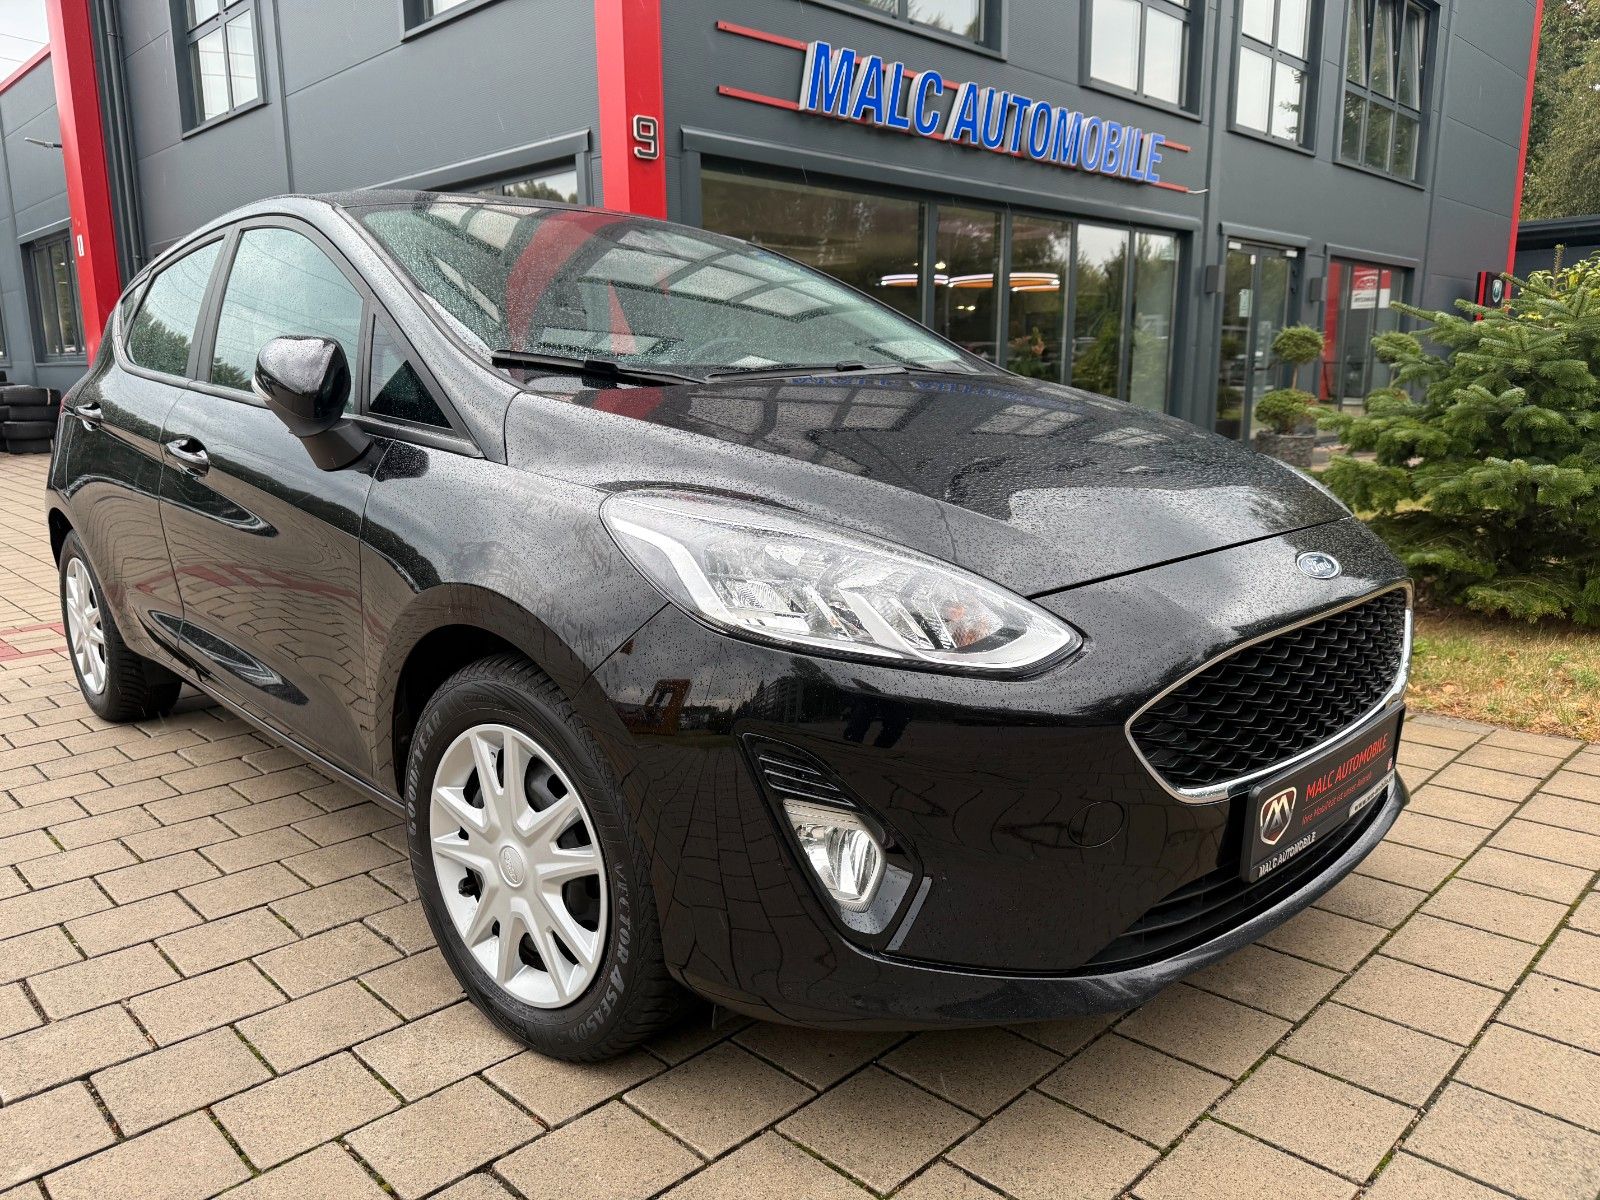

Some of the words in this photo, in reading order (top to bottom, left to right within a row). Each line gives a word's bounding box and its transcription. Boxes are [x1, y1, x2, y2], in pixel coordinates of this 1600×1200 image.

[633, 114, 659, 159] 9
[800, 40, 944, 136] MALC
[943, 81, 1166, 184] AUTOMOBILE
[1305, 557, 1332, 573] Ford
[406, 710, 442, 836] GOODYEAR
[1305, 769, 1335, 801] MALC
[1334, 733, 1388, 784] AUTOMOBILE
[1258, 857, 1279, 878] MALC
[1278, 831, 1317, 865] AUTOMOBILE
[612, 859, 631, 965] VECTOR
